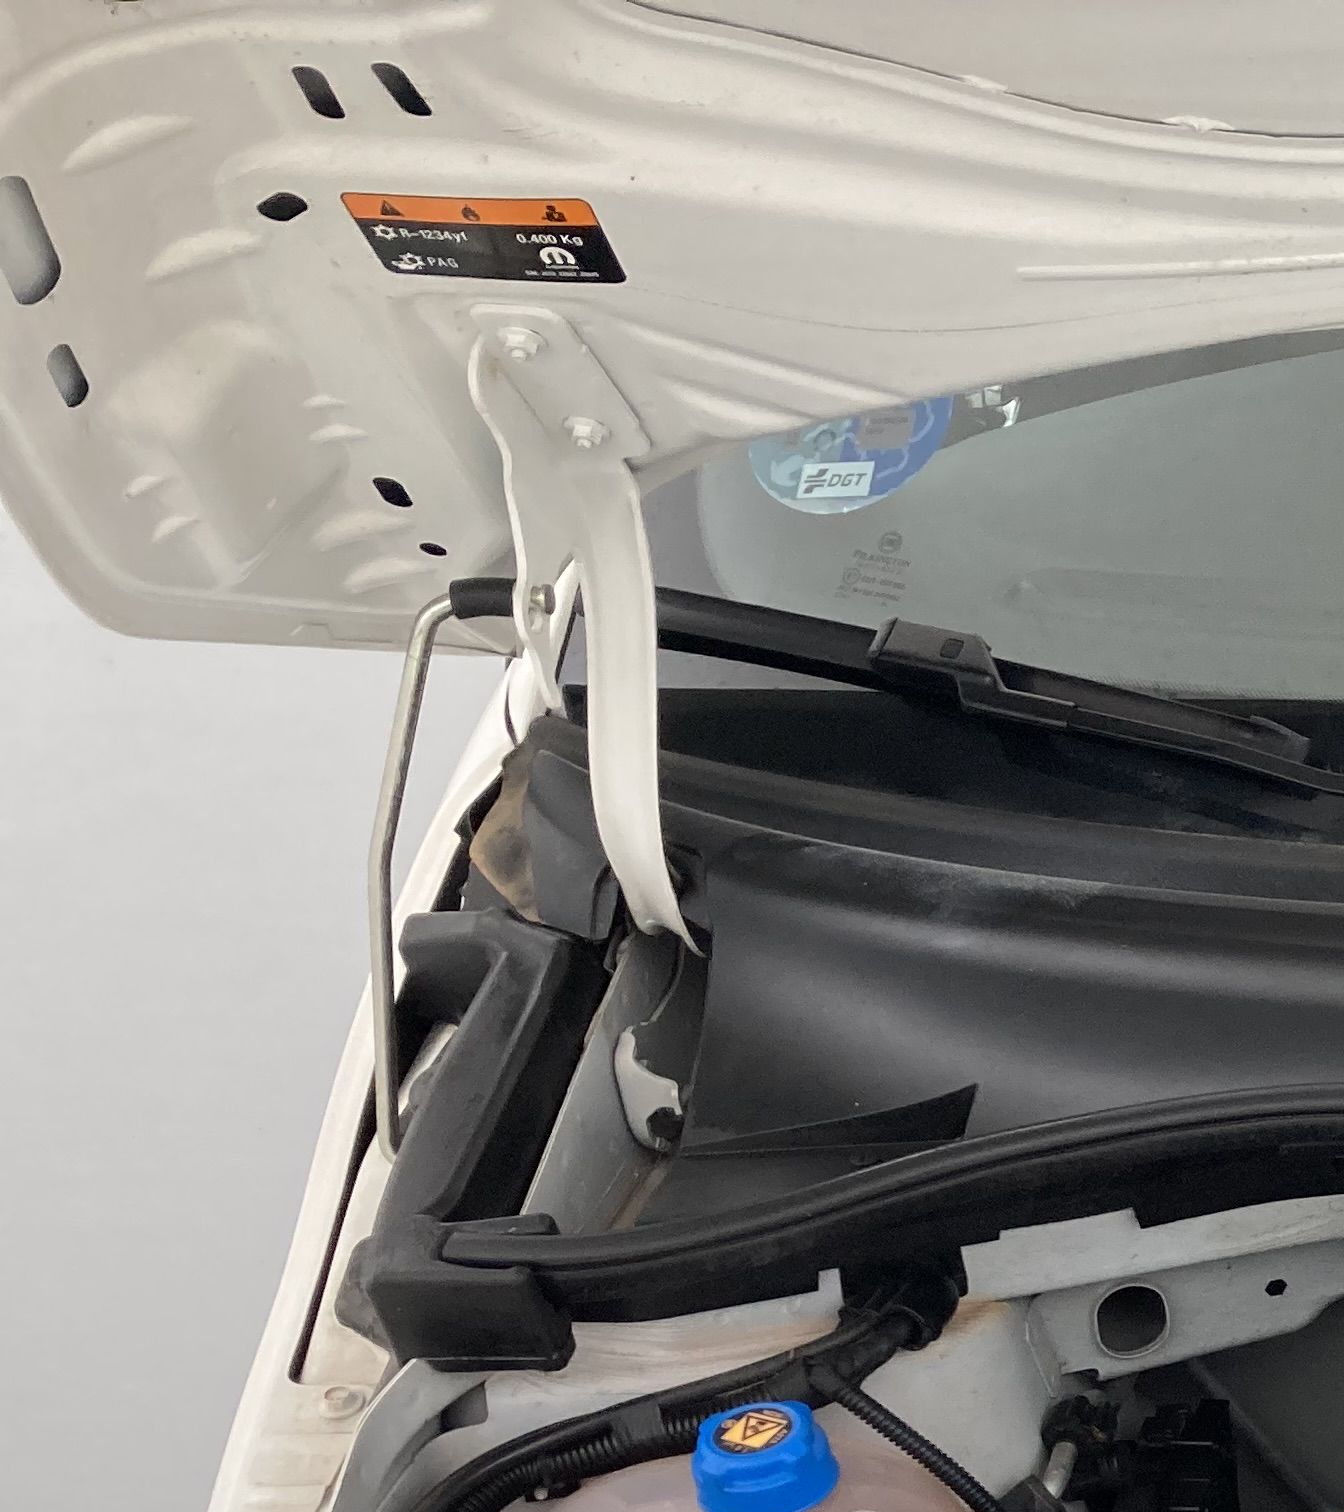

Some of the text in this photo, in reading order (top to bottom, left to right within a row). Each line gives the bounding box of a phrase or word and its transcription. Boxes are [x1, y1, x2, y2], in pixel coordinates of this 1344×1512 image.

[515, 232, 584, 247] 0.400 Kg
[426, 256, 459, 269] PAG
[829, 472, 868, 488] DGT
